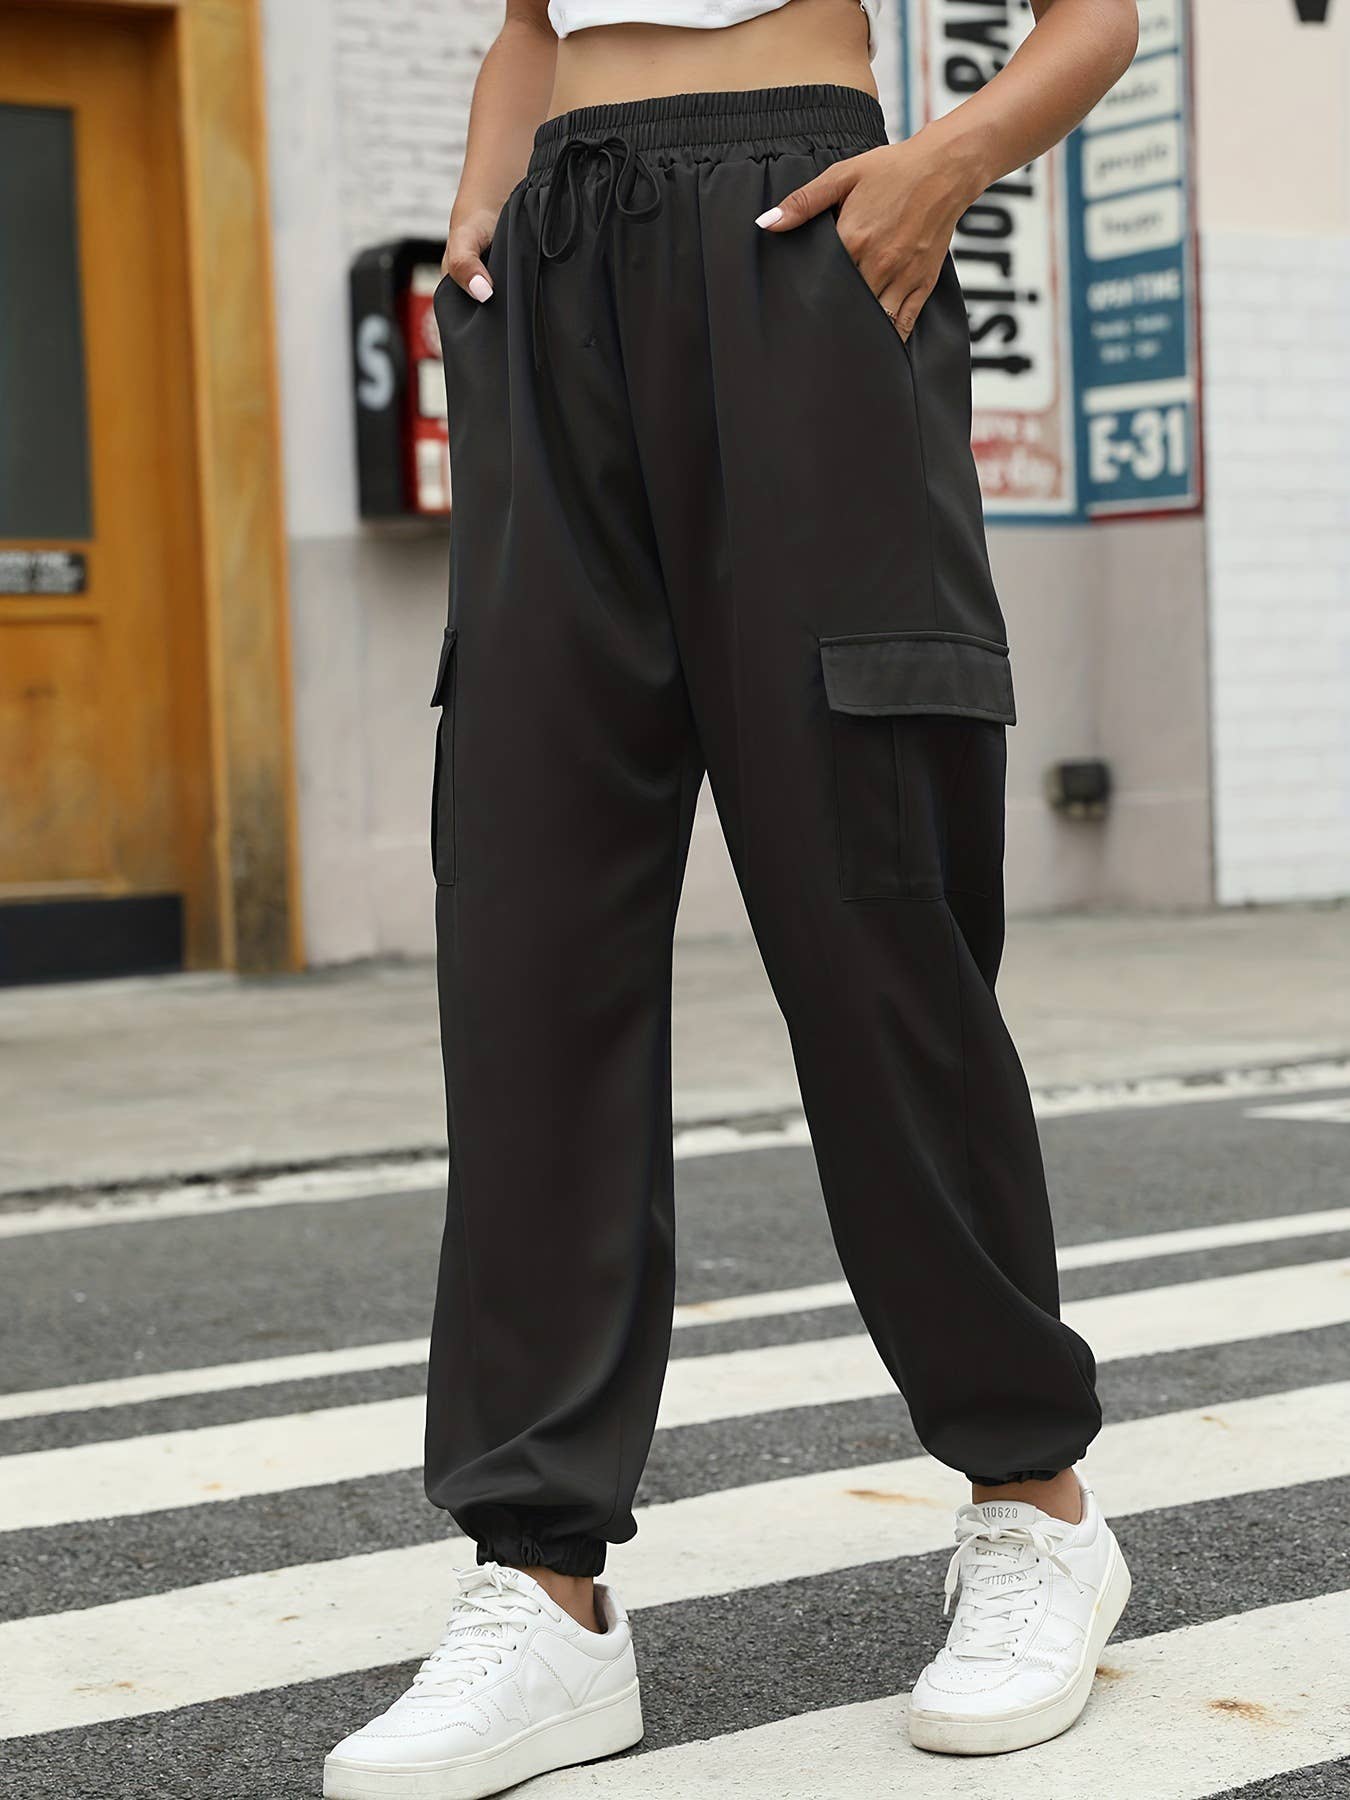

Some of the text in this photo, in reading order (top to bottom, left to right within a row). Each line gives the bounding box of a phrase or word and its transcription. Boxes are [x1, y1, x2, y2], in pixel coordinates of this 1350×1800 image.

[956, 163, 1037, 375] lorist
[357, 313, 395, 411] S
[1090, 407, 1186, 483] E-31
